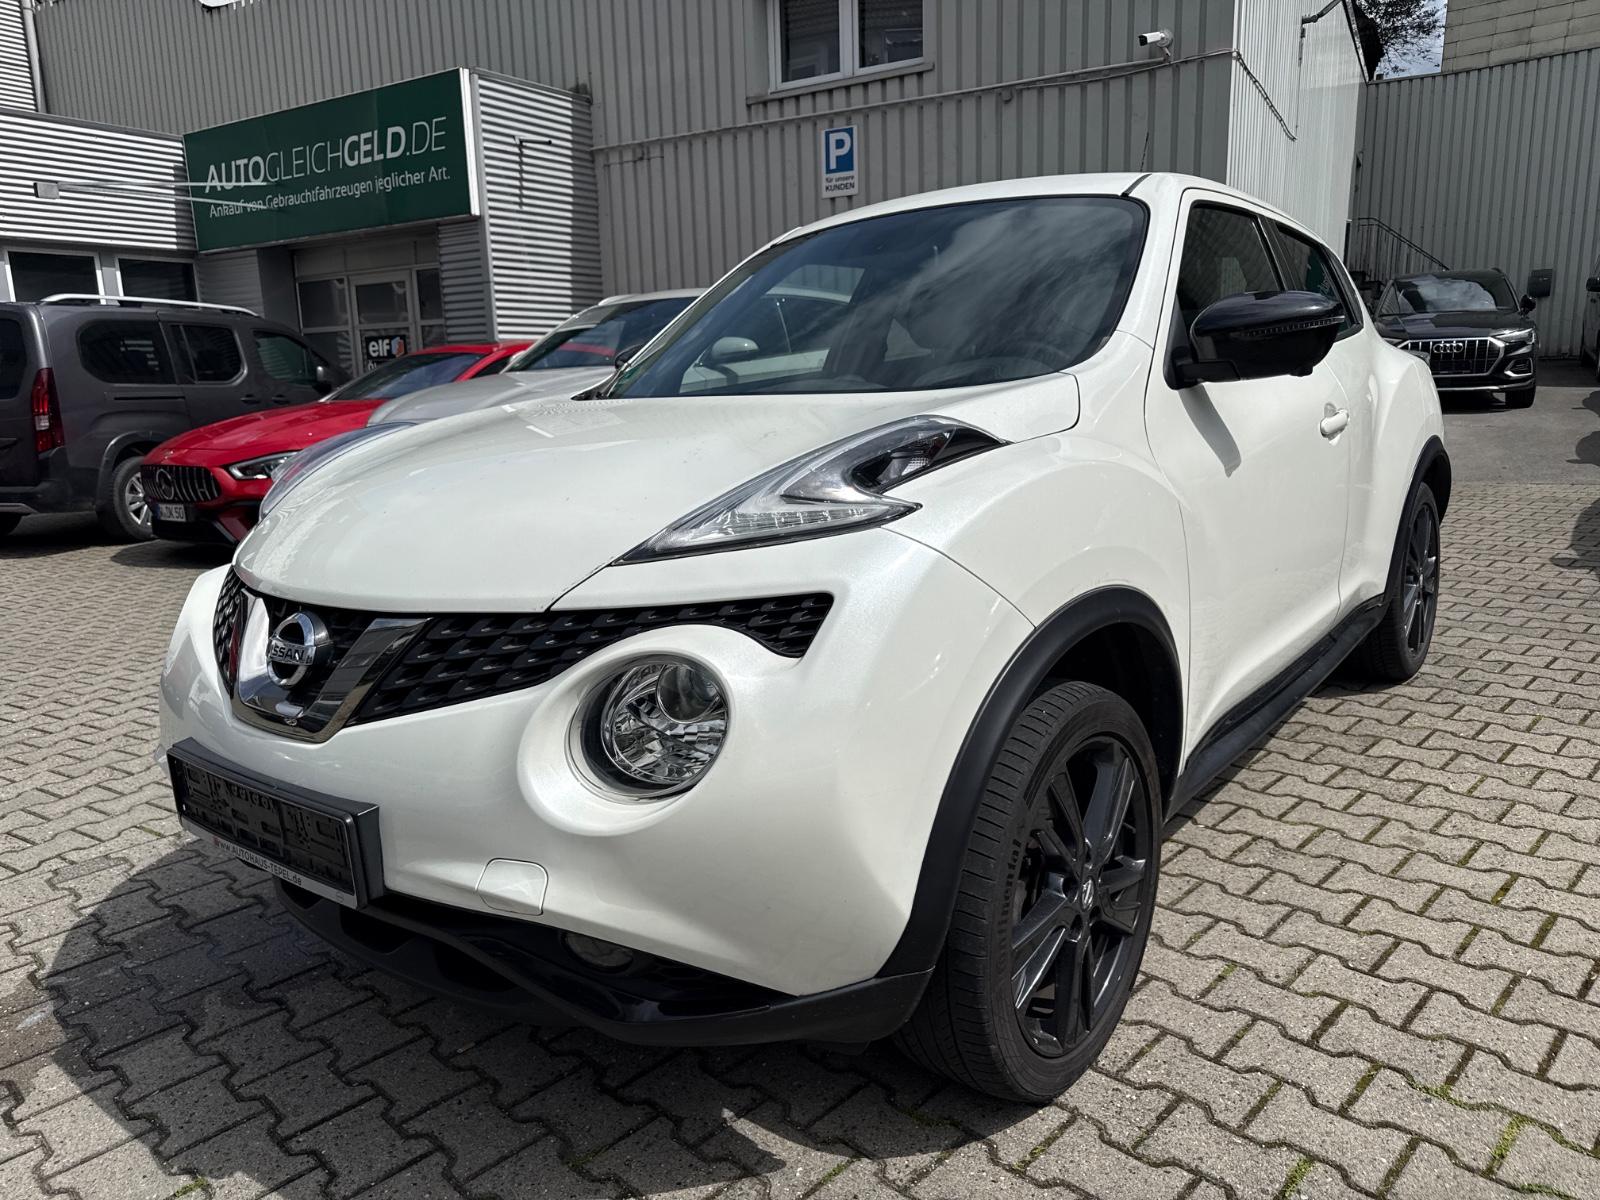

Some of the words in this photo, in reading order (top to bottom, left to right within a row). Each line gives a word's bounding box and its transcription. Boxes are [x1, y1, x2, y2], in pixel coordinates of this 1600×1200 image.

[205, 116, 447, 194] AUTOGLEICHGELD.DE
[829, 131, 851, 170] P
[209, 200, 244, 218] Ankauf
[247, 197, 264, 213] von
[265, 178, 373, 210] Gebrauchtfahrzeugen
[374, 167, 426, 195] jeglicher
[428, 165, 450, 182] Art.
[825, 182, 855, 192] KUNDEN
[368, 339, 391, 357] elf
[271, 645, 304, 660] SSAN
